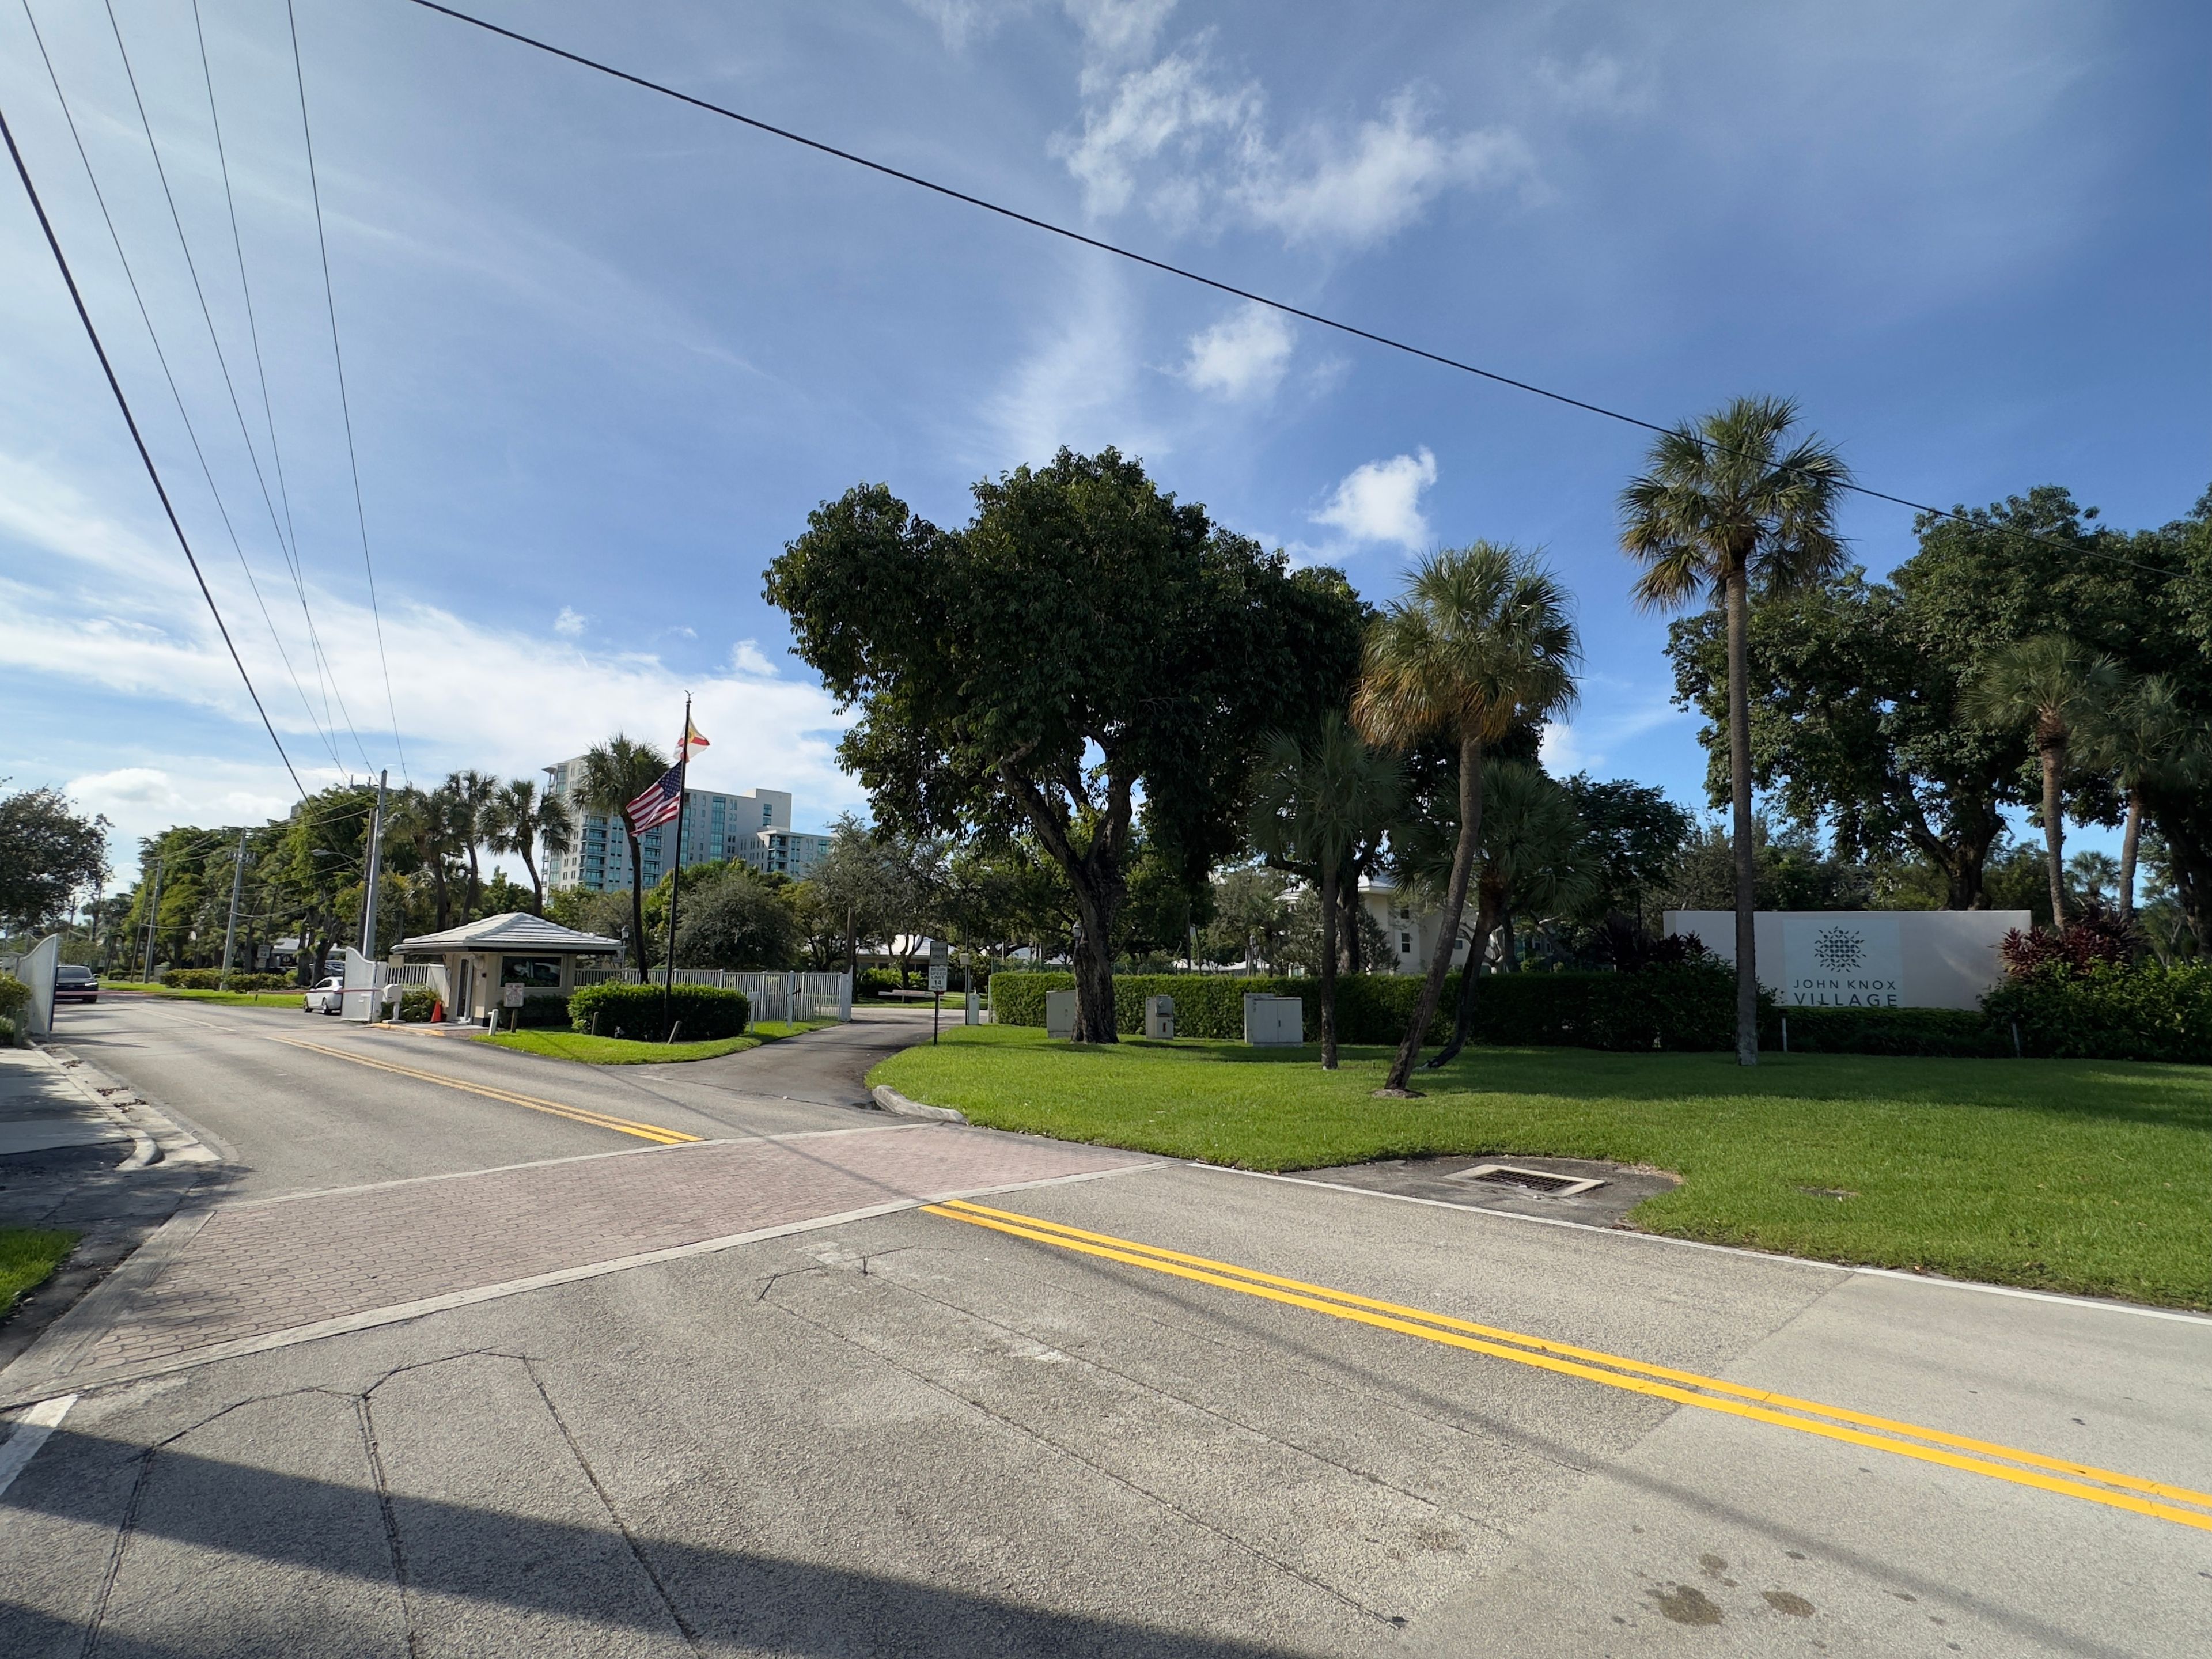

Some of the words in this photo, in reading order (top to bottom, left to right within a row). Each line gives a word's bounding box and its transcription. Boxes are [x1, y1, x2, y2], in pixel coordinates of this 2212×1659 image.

[1793, 979, 1839, 989] JOHN
[1847, 980, 1896, 990] KNOX
[1794, 992, 1898, 1007] VILLAGE
